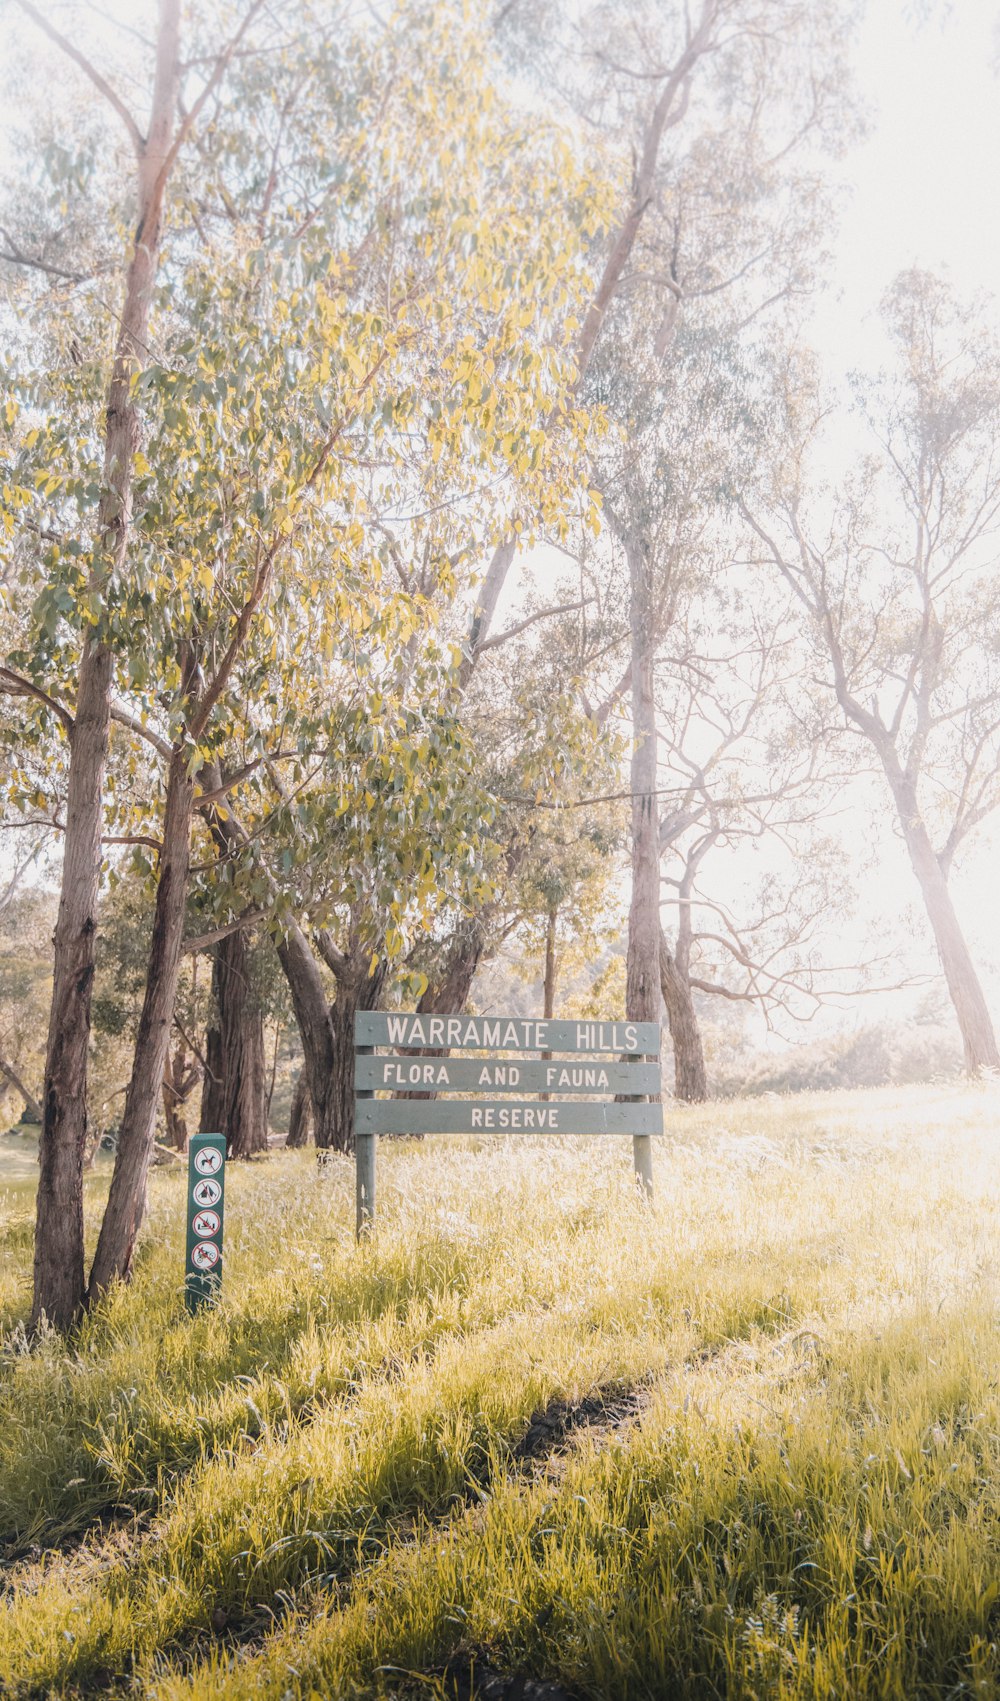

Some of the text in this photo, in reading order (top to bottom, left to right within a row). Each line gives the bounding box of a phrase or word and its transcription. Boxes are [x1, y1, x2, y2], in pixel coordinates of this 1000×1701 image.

[386, 1017, 638, 1050] WARRAMATE HILLS
[383, 1063, 610, 1087] FLORA AND FAUNA
[471, 1108, 559, 1128] RESERVE
